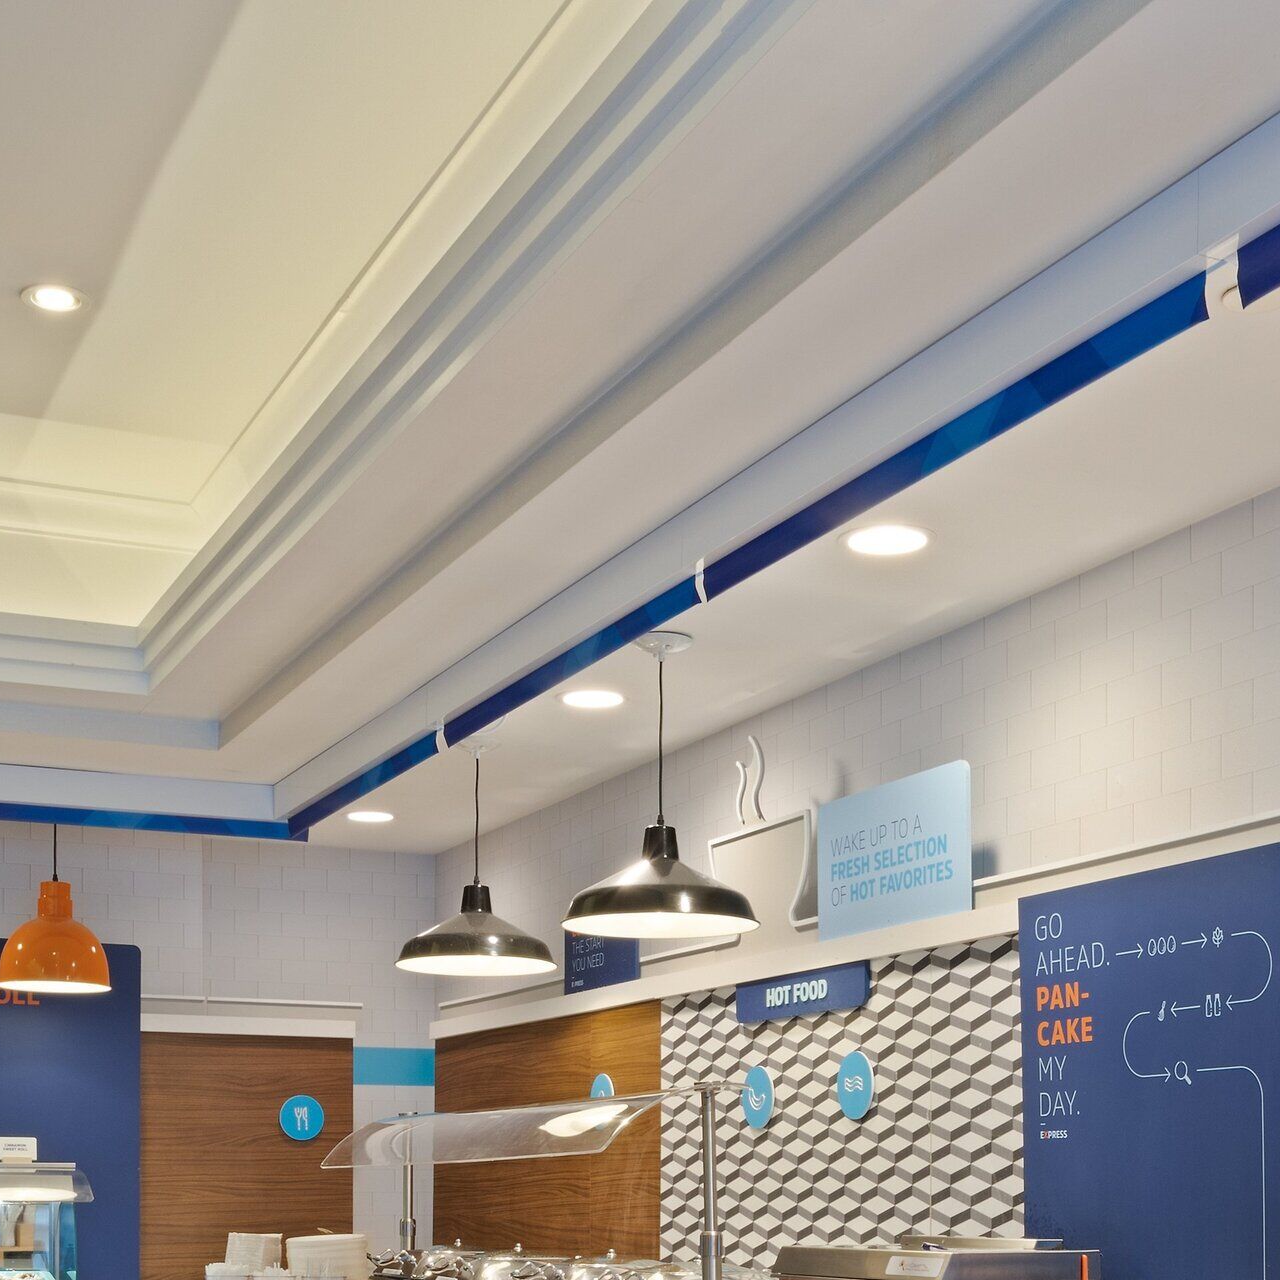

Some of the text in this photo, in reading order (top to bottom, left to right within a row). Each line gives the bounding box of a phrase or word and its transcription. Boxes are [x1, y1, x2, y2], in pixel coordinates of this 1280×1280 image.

[831, 814, 923, 857] WAKE UP TO A
[831, 833, 948, 882] FRESH SELECTION
[831, 859, 954, 907] OF HOT FAVORITES
[1035, 913, 1063, 941] GO
[572, 936, 605, 955] THE START
[1035, 942, 1111, 977] AHEAD.
[572, 952, 605, 972] YOU NEED
[766, 979, 828, 1008] HOT FOOD
[1036, 981, 1090, 1012] PAN-
[1037, 1016, 1093, 1047] CAKE
[1038, 1055, 1068, 1082] MY
[1039, 1090, 1080, 1117] DAY.
[1040, 1130, 1068, 1140] EXPRESS
